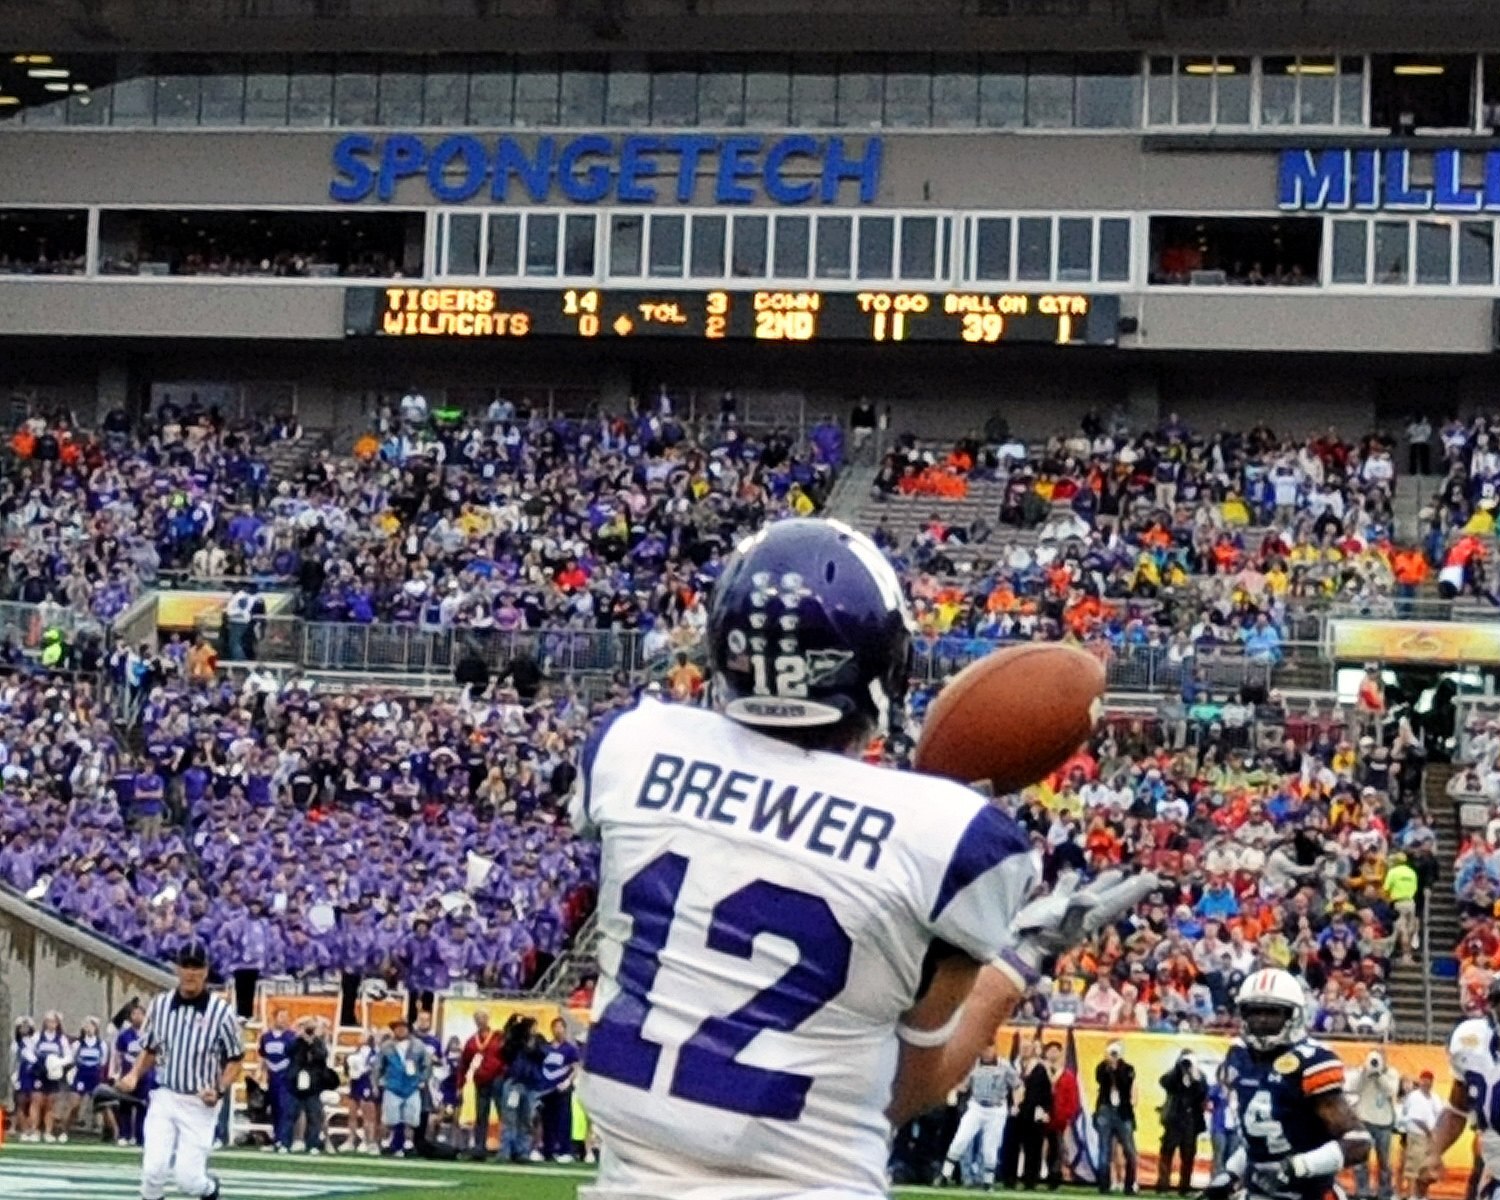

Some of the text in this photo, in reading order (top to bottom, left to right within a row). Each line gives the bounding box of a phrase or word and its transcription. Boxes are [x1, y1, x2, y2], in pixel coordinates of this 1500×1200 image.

[330, 133, 884, 205] SPONGETECH
[386, 288, 598, 314] TIGERS 14
[706, 291, 728, 315] 3
[754, 291, 820, 311] DOWN
[857, 292, 930, 313] TO GO
[944, 293, 1028, 314] BALL ON
[1038, 294, 1088, 315] QTR
[383, 311, 599, 337] WILDCATS 0
[705, 315, 726, 339] 2
[756, 310, 814, 341] 2ND
[873, 311, 905, 342] 11
[961, 312, 1003, 343] 39
[1058, 314, 1072, 345] 1
[750, 654, 808, 697] 12
[635, 753, 897, 872] BREWER
[583, 850, 853, 1122] 12
